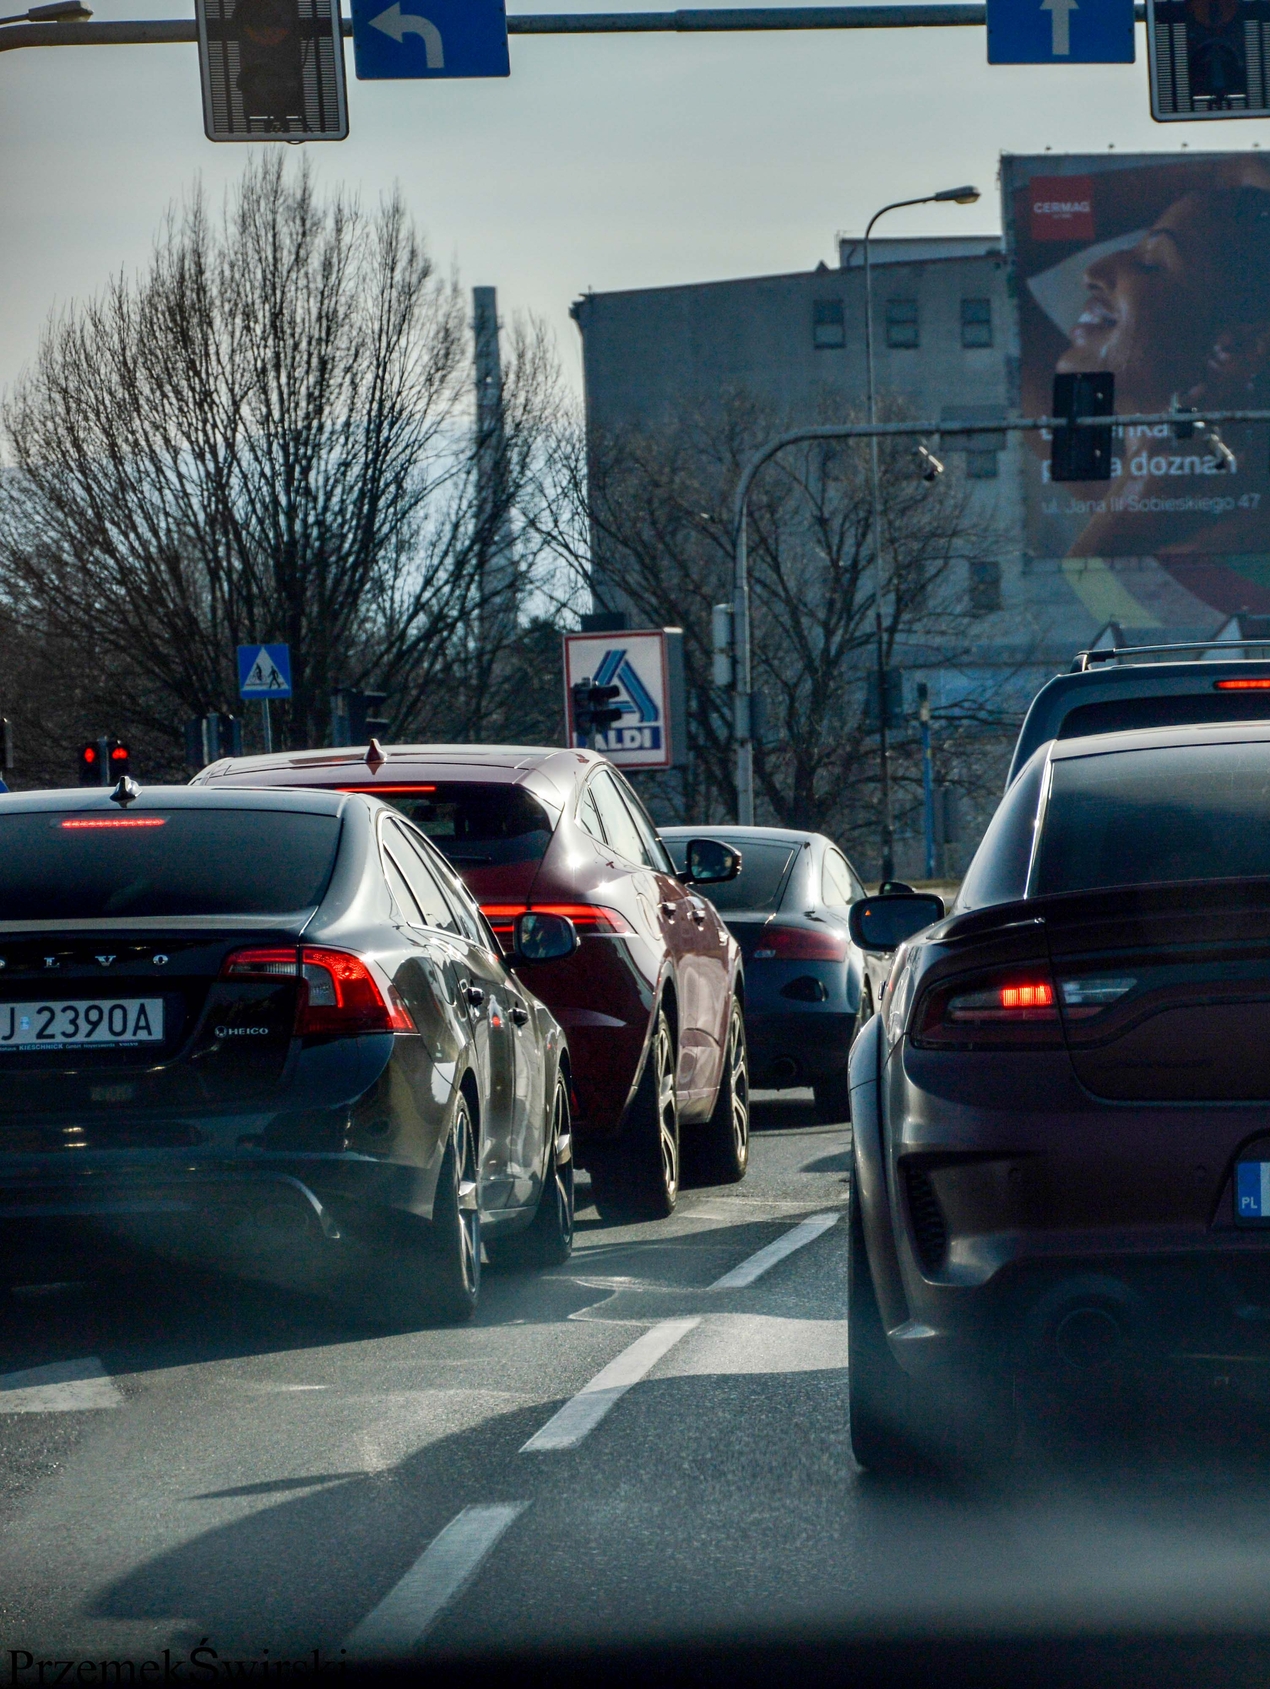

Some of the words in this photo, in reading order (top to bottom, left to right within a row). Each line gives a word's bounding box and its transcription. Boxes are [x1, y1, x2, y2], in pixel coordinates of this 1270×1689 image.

[1238, 493, 1261, 509] 47
[36, 1003, 153, 1040] 2390A
[228, 1027, 269, 1036] HEICO
[1241, 1197, 1258, 1209] PL
